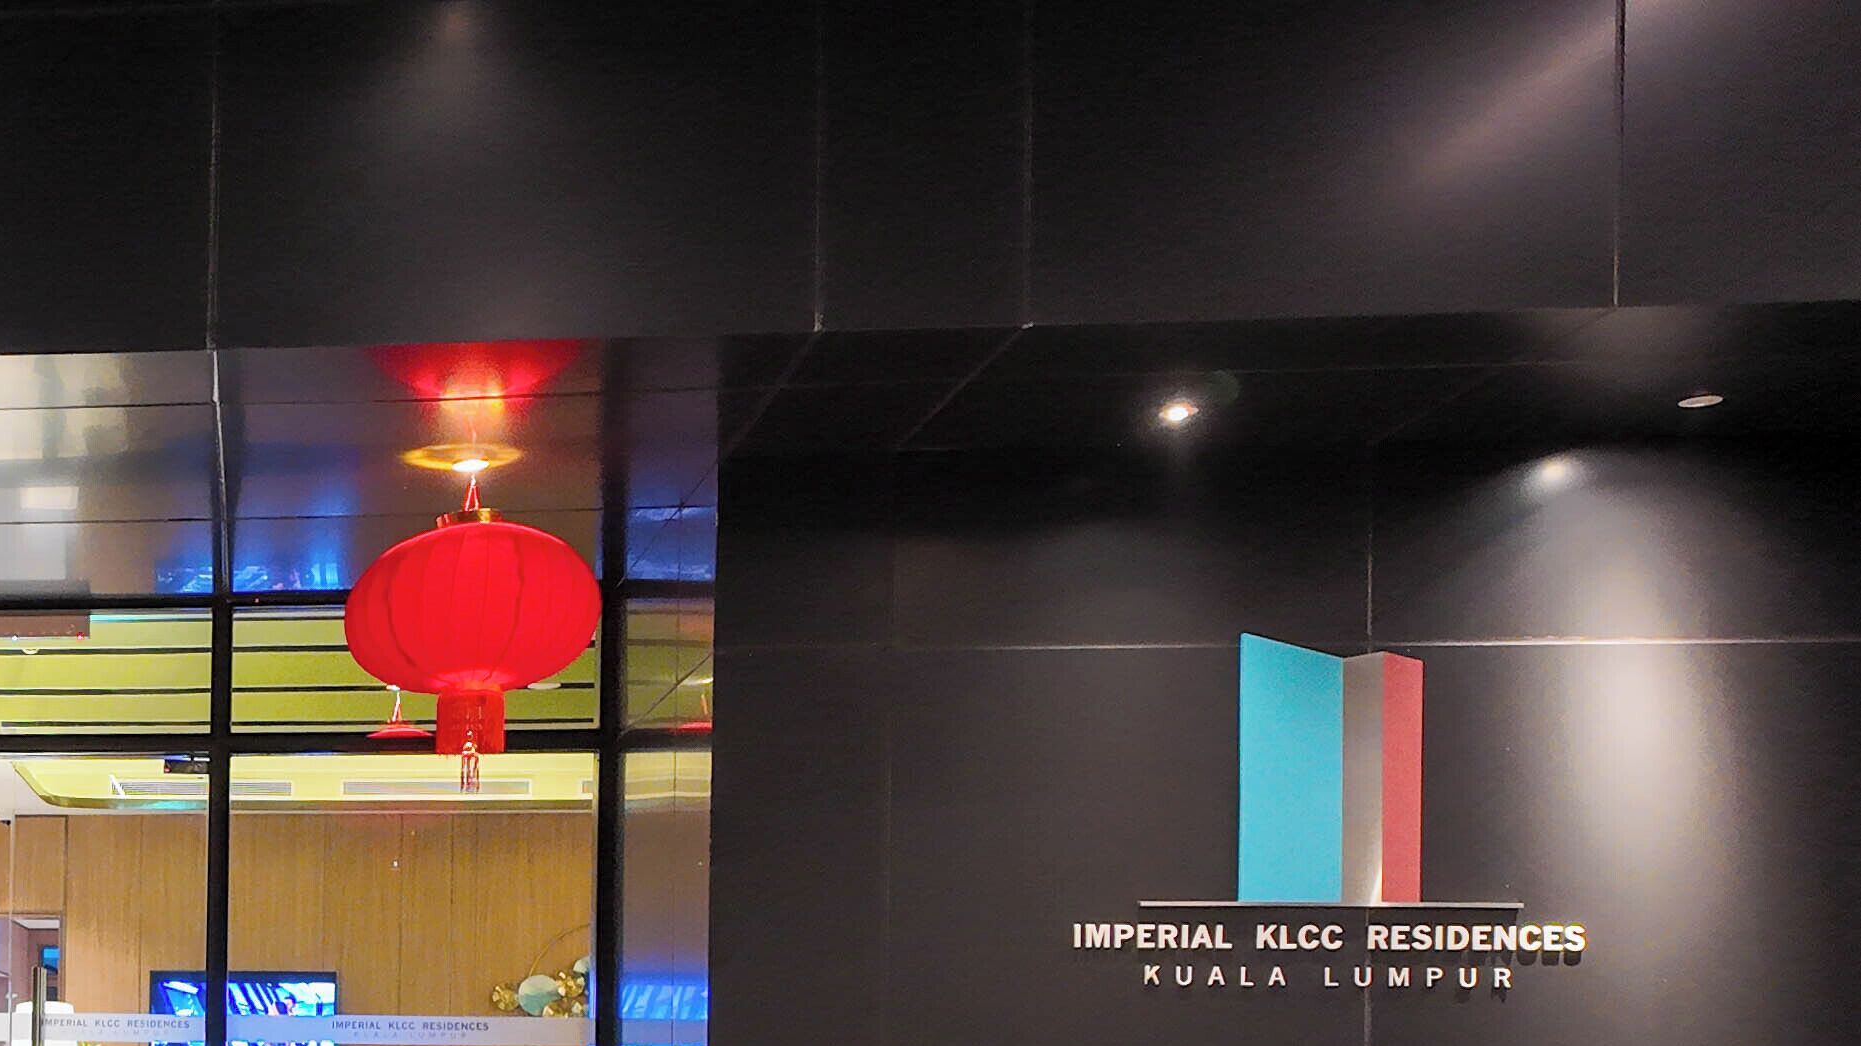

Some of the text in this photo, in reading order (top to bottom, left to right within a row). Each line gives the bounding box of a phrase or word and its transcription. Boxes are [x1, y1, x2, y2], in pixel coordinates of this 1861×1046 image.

[1072, 922, 1587, 953] IMPERIAL KLCC RESIDENCES
[1143, 964, 1512, 989] KUALA LUMPUR
